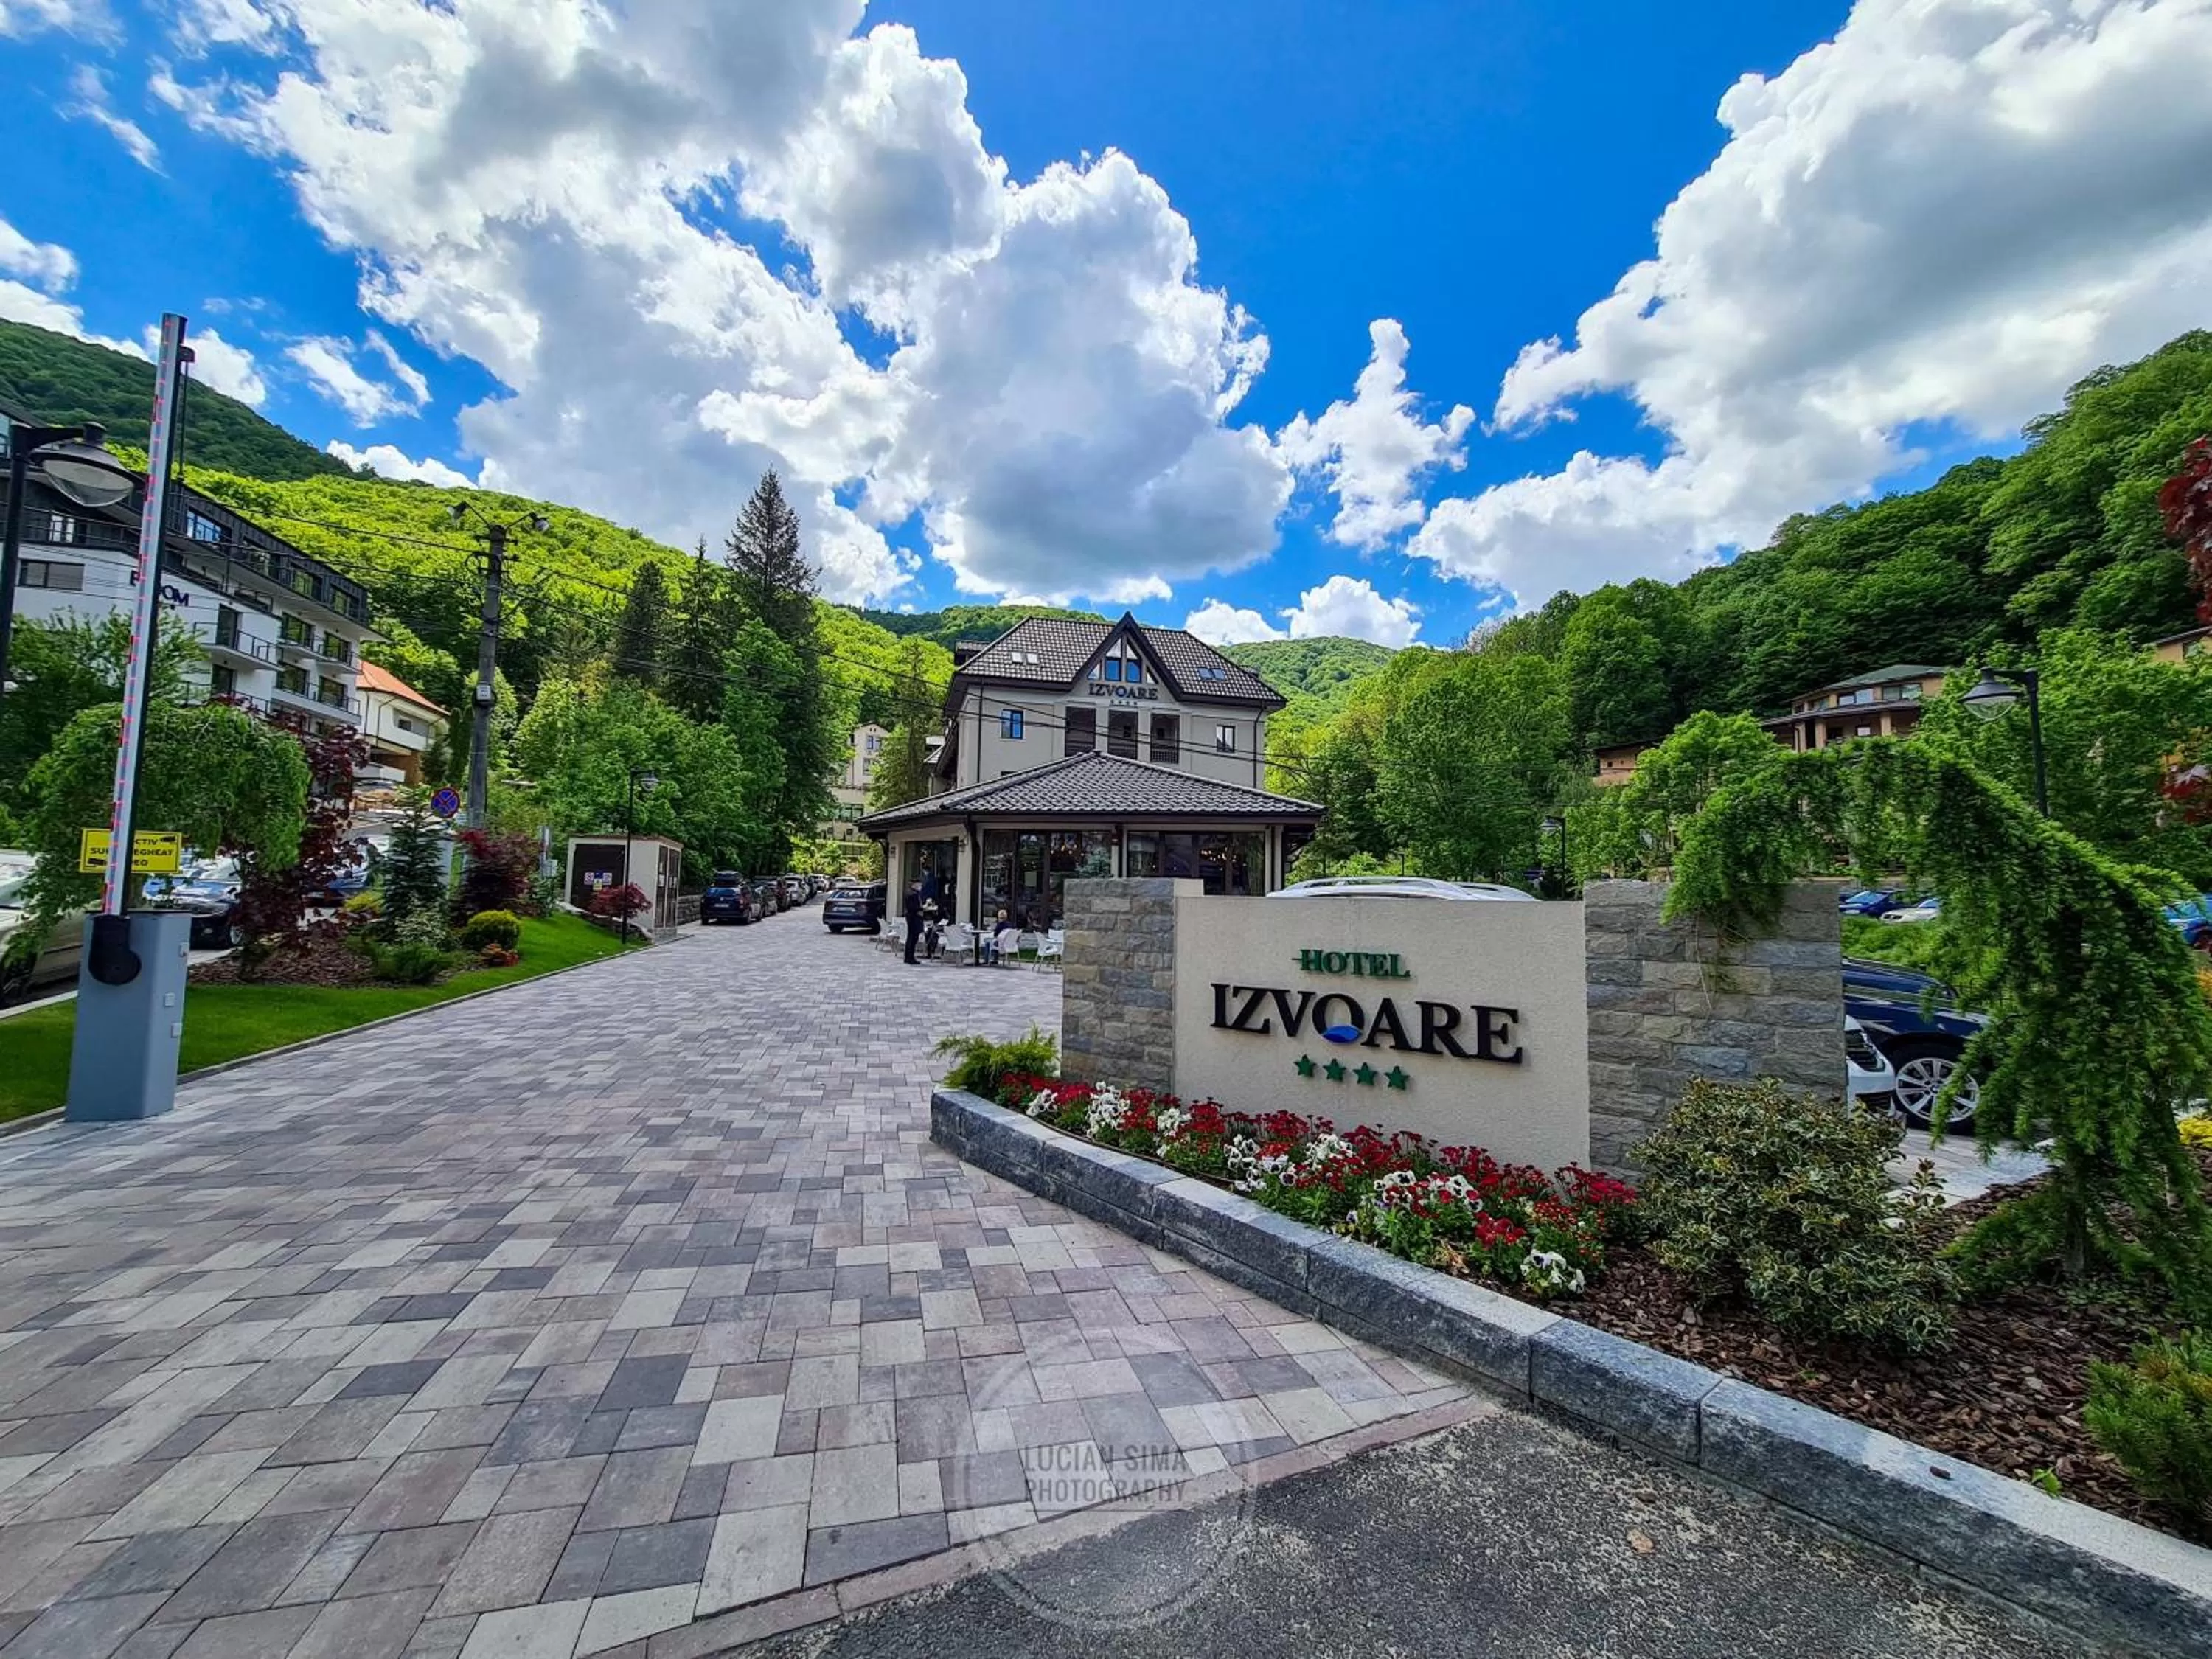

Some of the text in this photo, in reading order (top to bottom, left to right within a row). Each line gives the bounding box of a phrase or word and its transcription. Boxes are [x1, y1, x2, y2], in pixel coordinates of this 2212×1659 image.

[130, 570, 189, 606] BOM
[1088, 683, 1158, 700] IZVOARE
[1298, 948, 1411, 978] HOTEL
[1209, 982, 1523, 1064] IZVOARE
